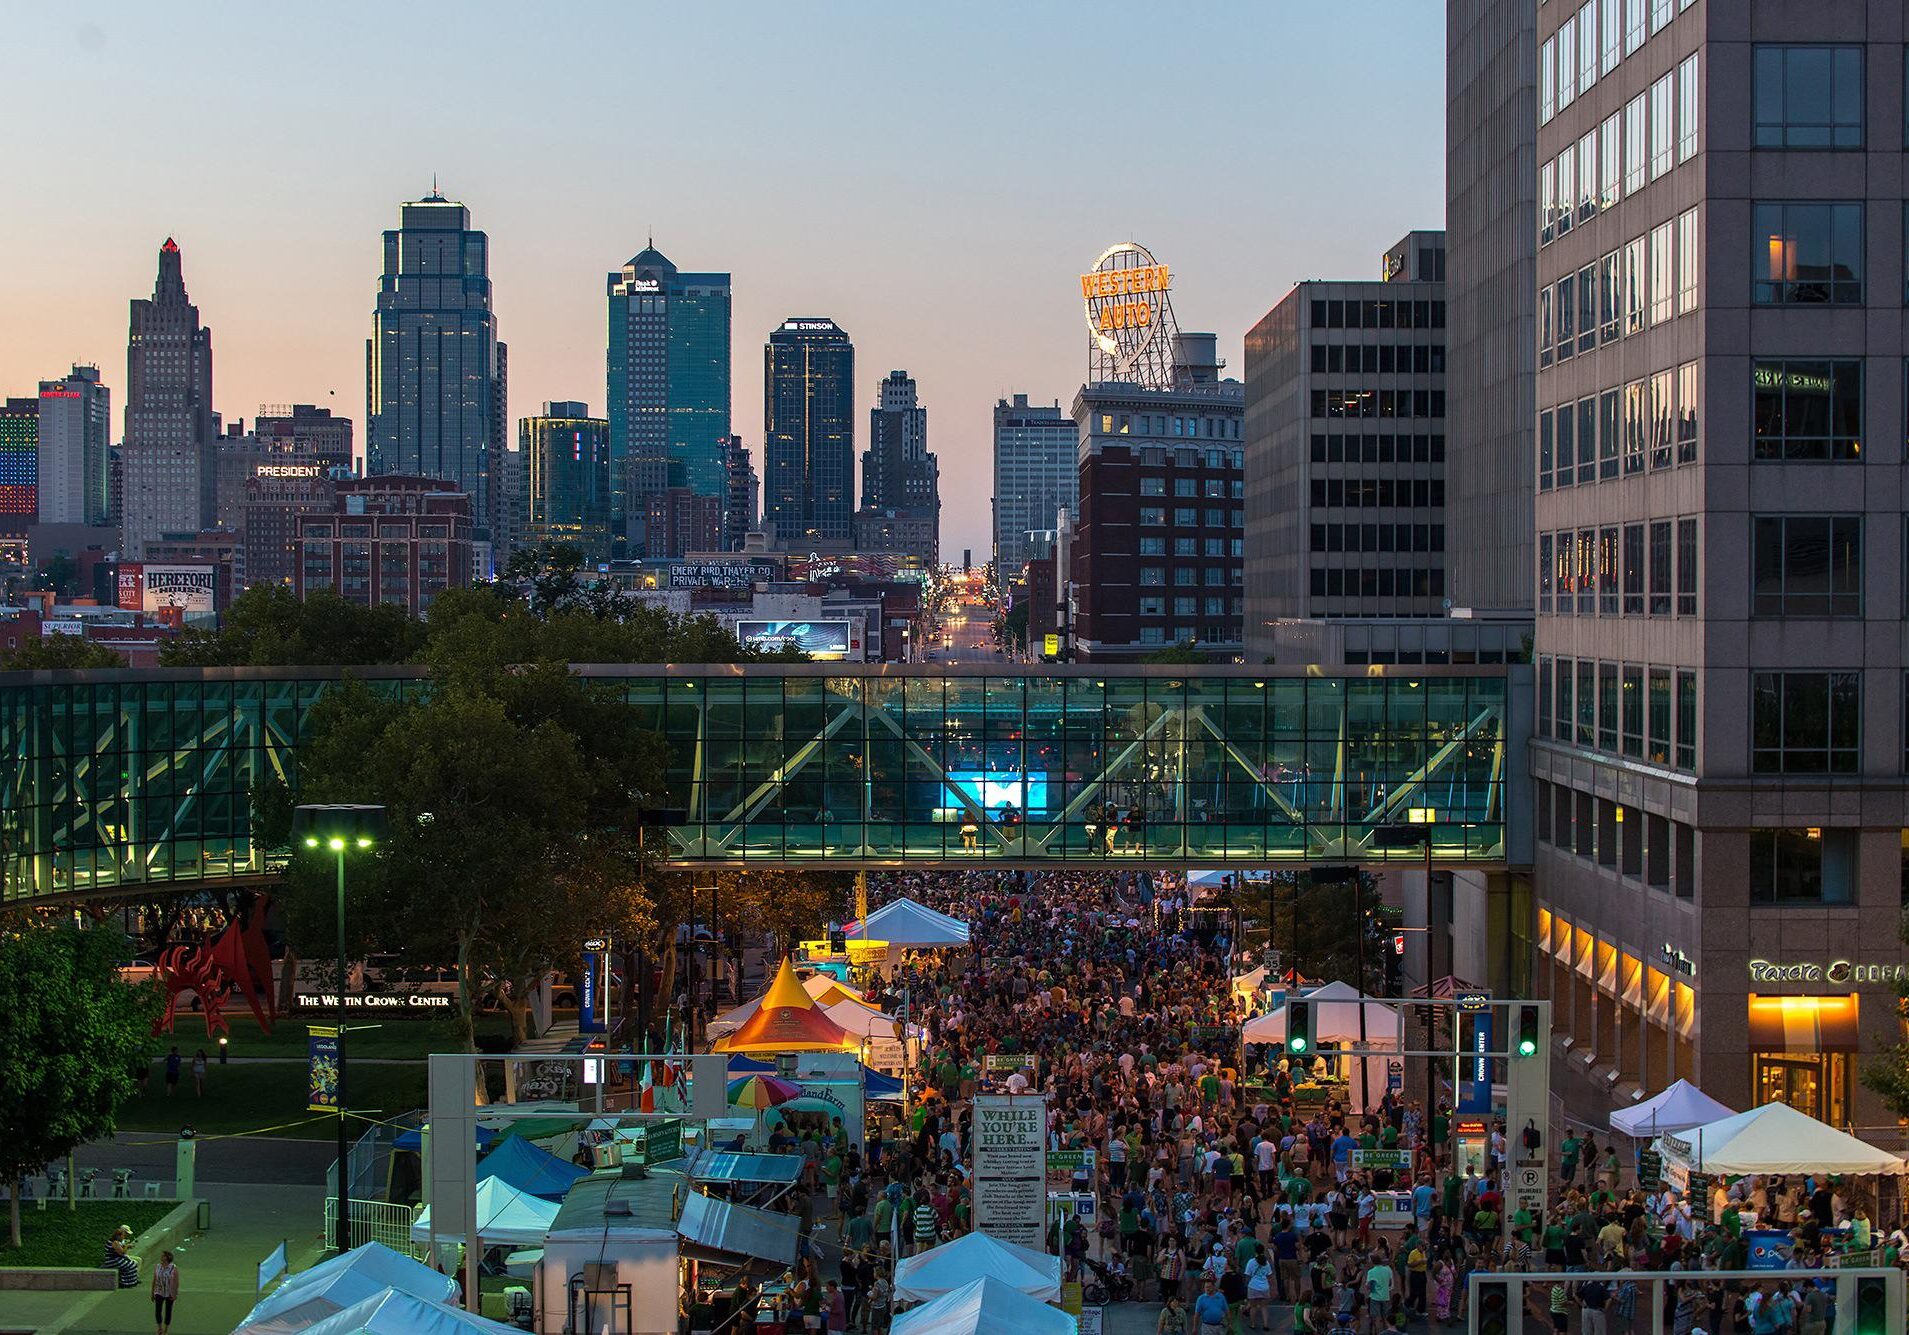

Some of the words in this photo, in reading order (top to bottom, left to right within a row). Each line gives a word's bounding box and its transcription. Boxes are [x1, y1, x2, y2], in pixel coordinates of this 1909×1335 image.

[1081, 264, 1169, 299] WESTERN
[1100, 301, 1151, 330] AUTO
[258, 466, 320, 476] PRESIDENT
[672, 566, 698, 576] EMERY
[723, 567, 755, 576] THAYER
[672, 576, 708, 586] PRIVATE
[1750, 960, 1822, 981] Panera
[298, 995, 319, 1006] THE
[321, 995, 362, 1006] WETIN
[409, 995, 449, 1006] CENTER
[982, 1110, 1037, 1120] WHILE
[982, 1122, 1037, 1132] YOU'RE
[982, 1134, 1037, 1144] HERE...
